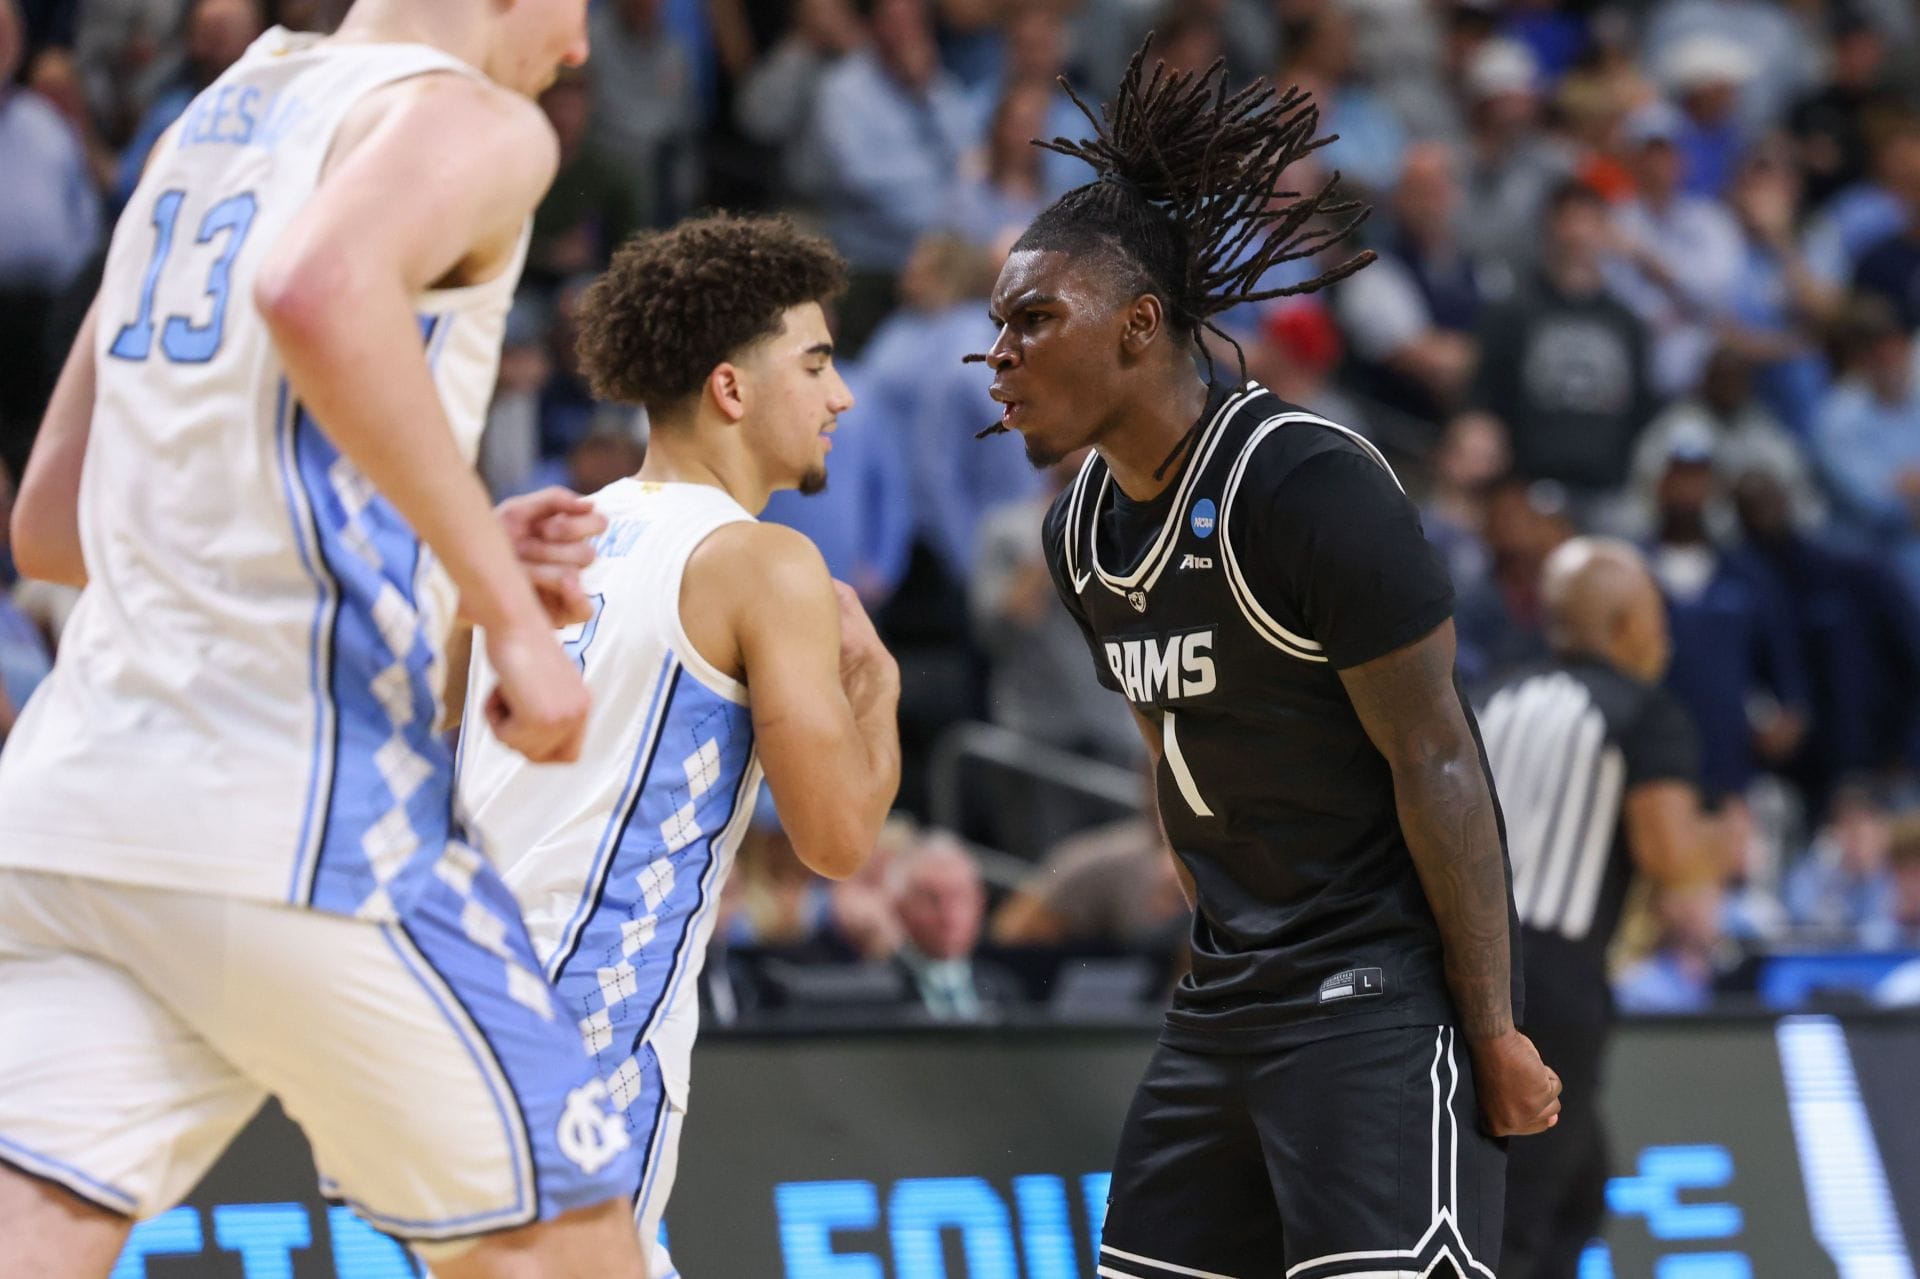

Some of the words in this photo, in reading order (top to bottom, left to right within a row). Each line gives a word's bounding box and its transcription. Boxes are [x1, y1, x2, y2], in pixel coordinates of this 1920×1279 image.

[108, 189, 259, 364] 13
[1193, 516, 1214, 529] NCAA
[1104, 630, 1217, 703] RAMS
[1163, 710, 1215, 817] 1
[1363, 975, 1372, 988] L
